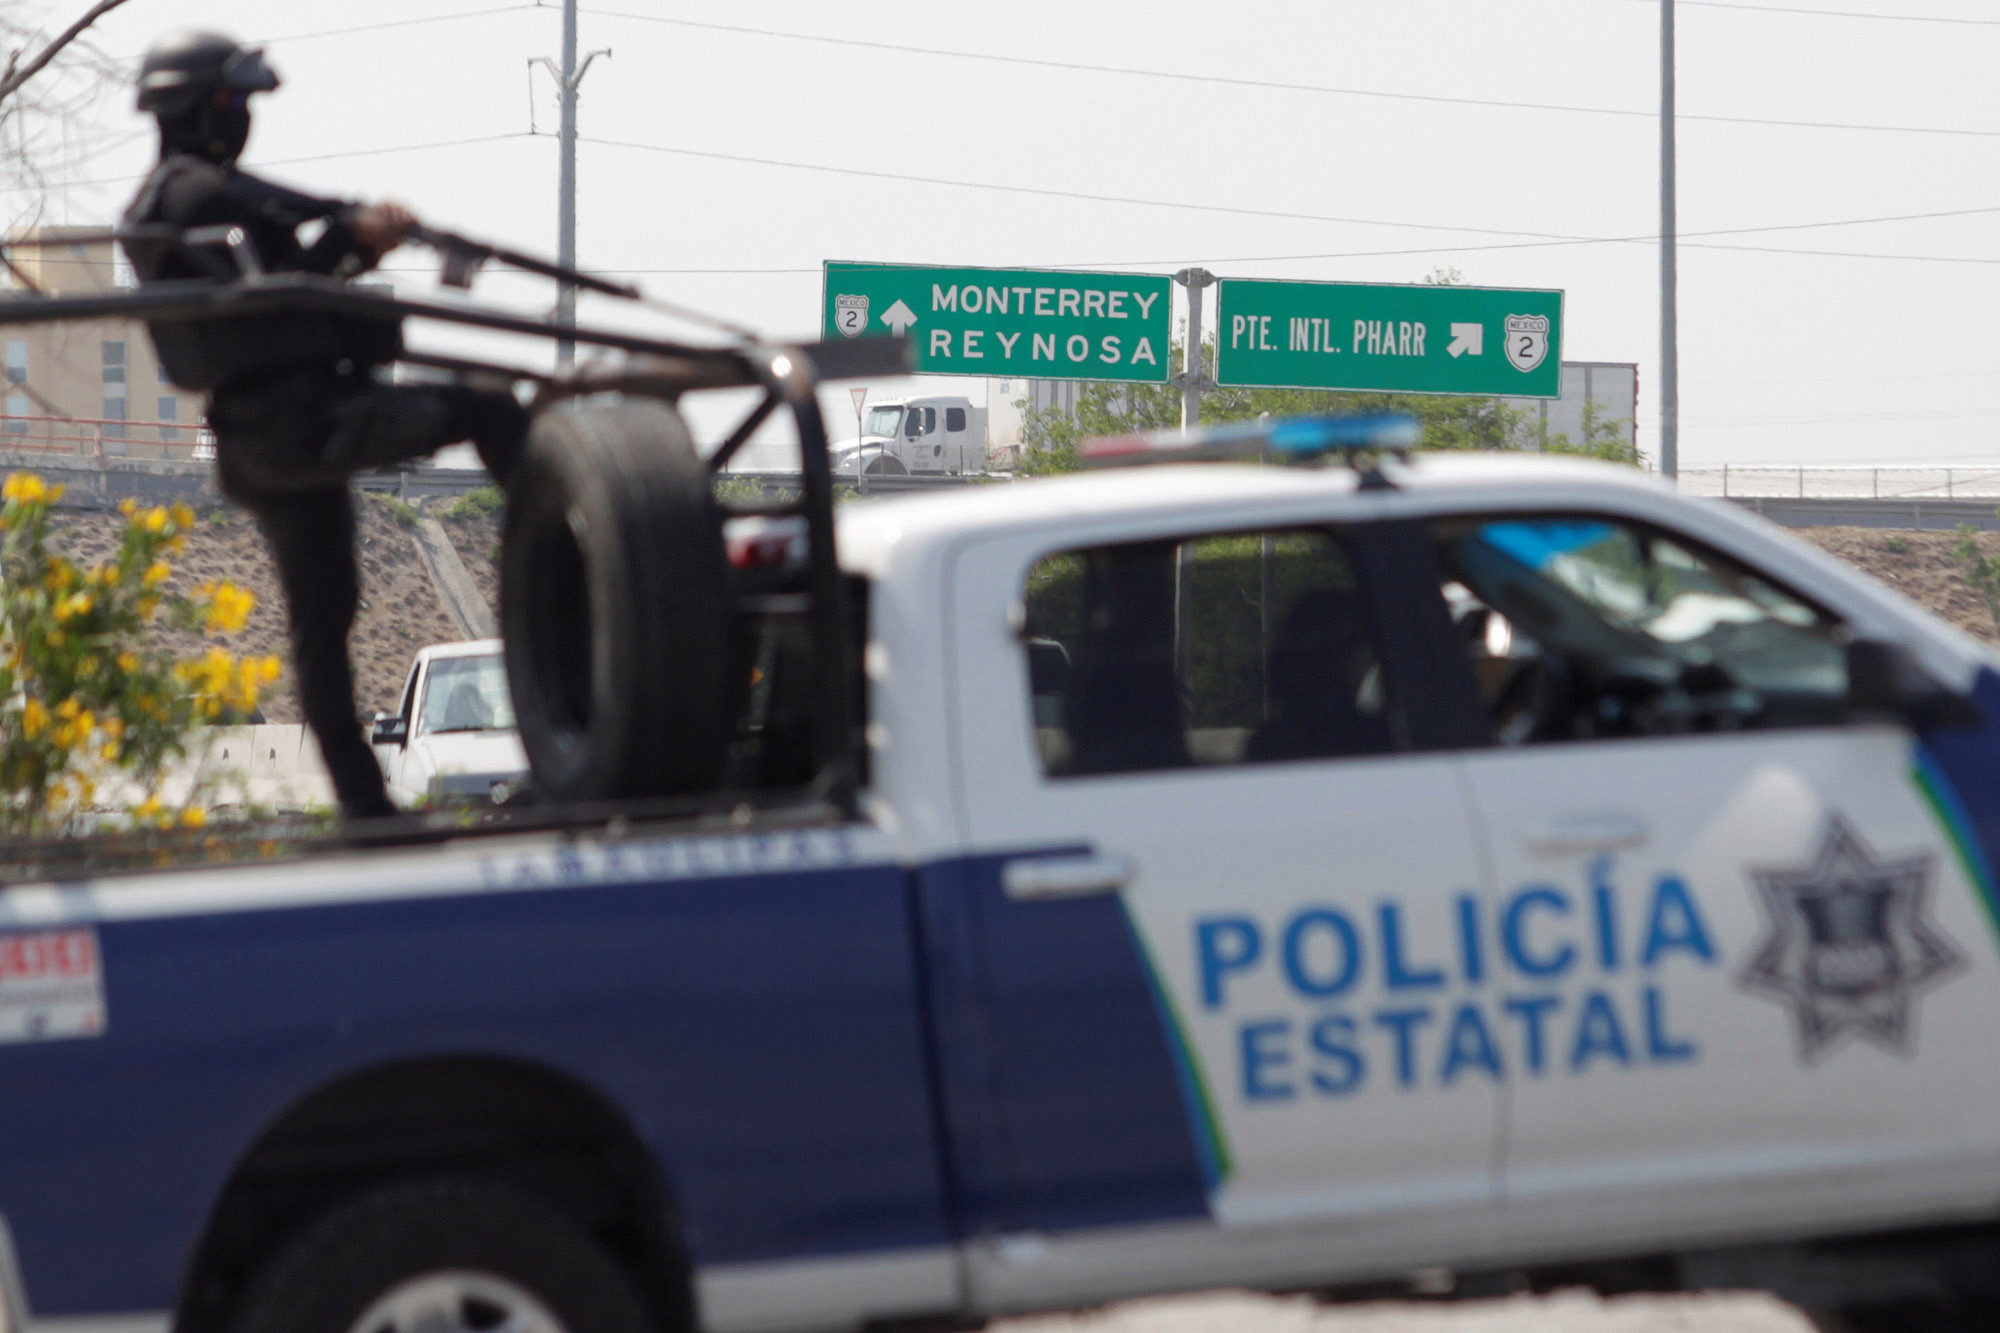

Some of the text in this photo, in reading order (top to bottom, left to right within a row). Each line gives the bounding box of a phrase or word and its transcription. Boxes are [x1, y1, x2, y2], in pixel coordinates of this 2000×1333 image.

[846, 310, 857, 328] 2
[931, 283, 1159, 321] MONTERREY
[1231, 314, 1427, 357] PTE. INTL. PHARR
[1510, 320, 1544, 330] MEXICO
[929, 329, 1157, 366] REYNOSA
[1519, 336, 1533, 358] 2
[1194, 855, 1721, 1012] POLICÍA
[1238, 986, 1700, 1106] ESTATAL
